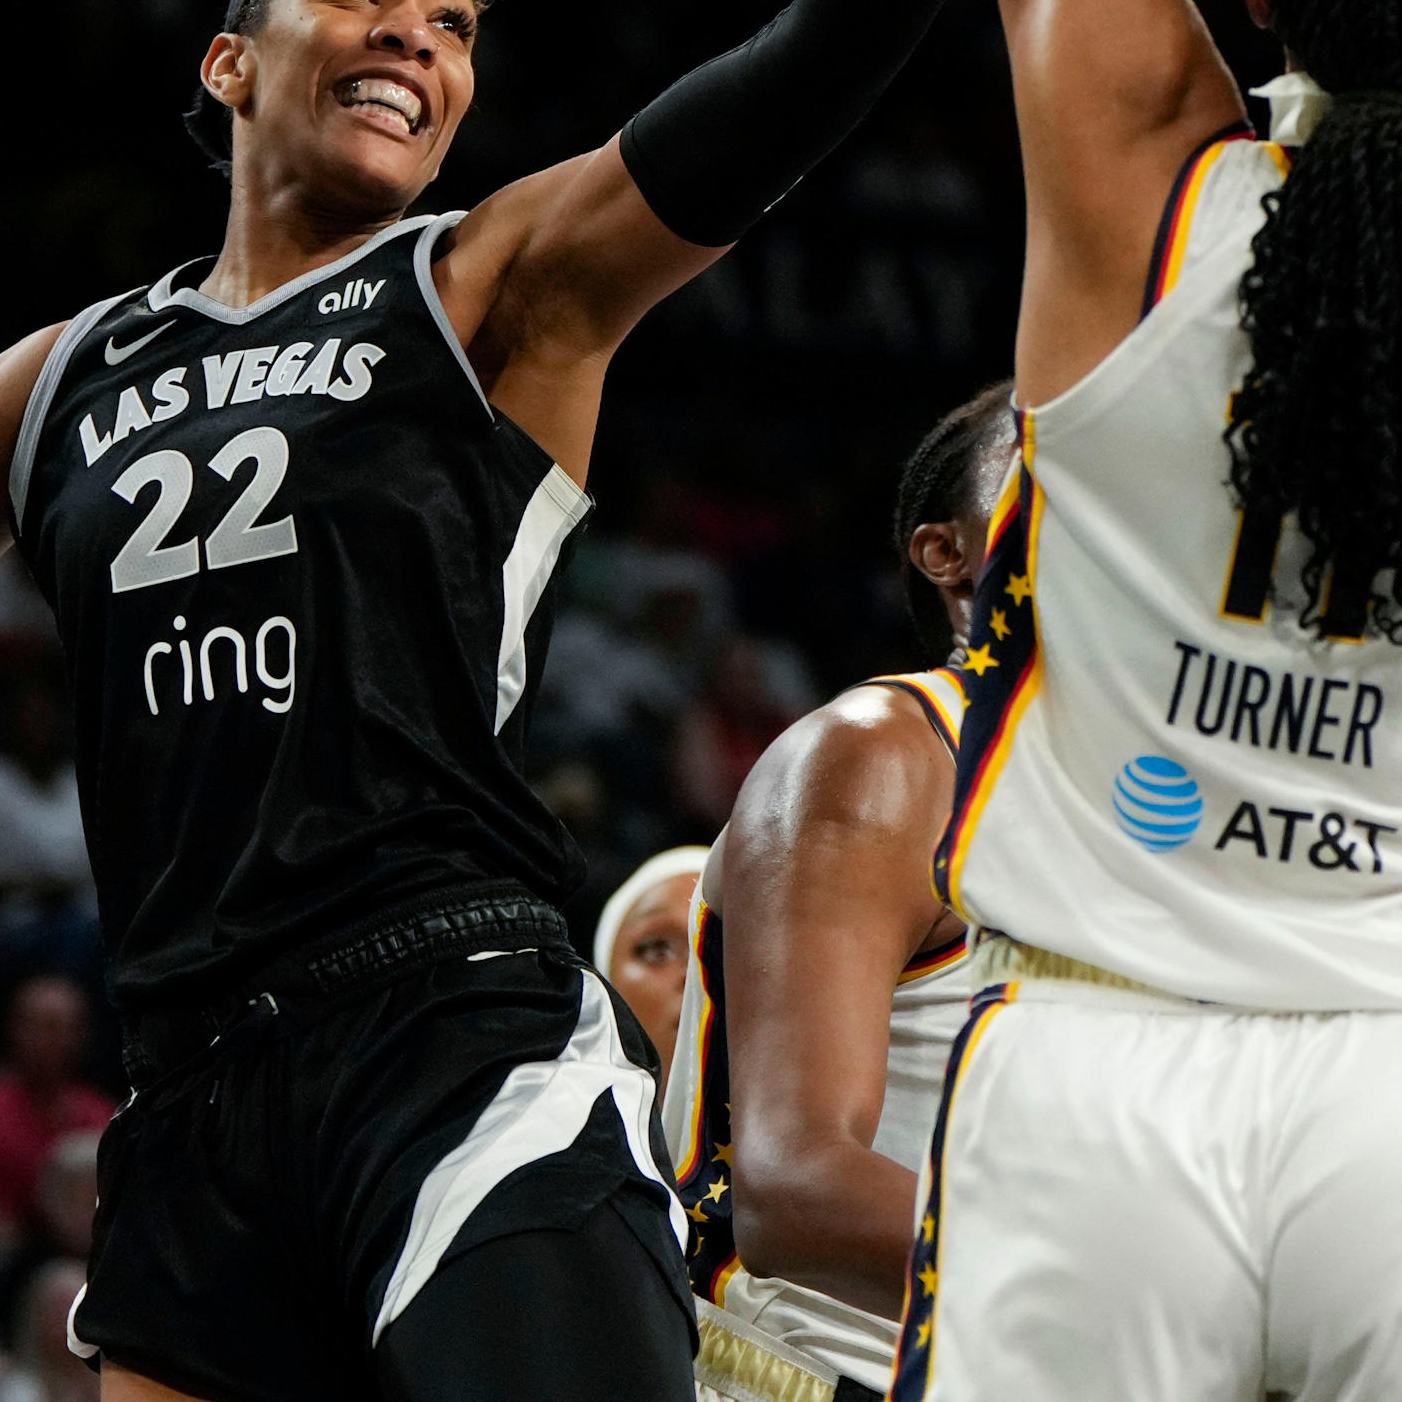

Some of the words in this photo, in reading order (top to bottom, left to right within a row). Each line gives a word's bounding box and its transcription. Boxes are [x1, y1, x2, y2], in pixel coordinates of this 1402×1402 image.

[317, 278, 388, 317] ally
[78, 366, 190, 468] LAS
[201, 338, 388, 410] VEGAS
[110, 426, 298, 594] 22
[144, 615, 296, 716] ring
[1166, 640, 1384, 768] TURNER
[1214, 801, 1399, 874] AT&T
